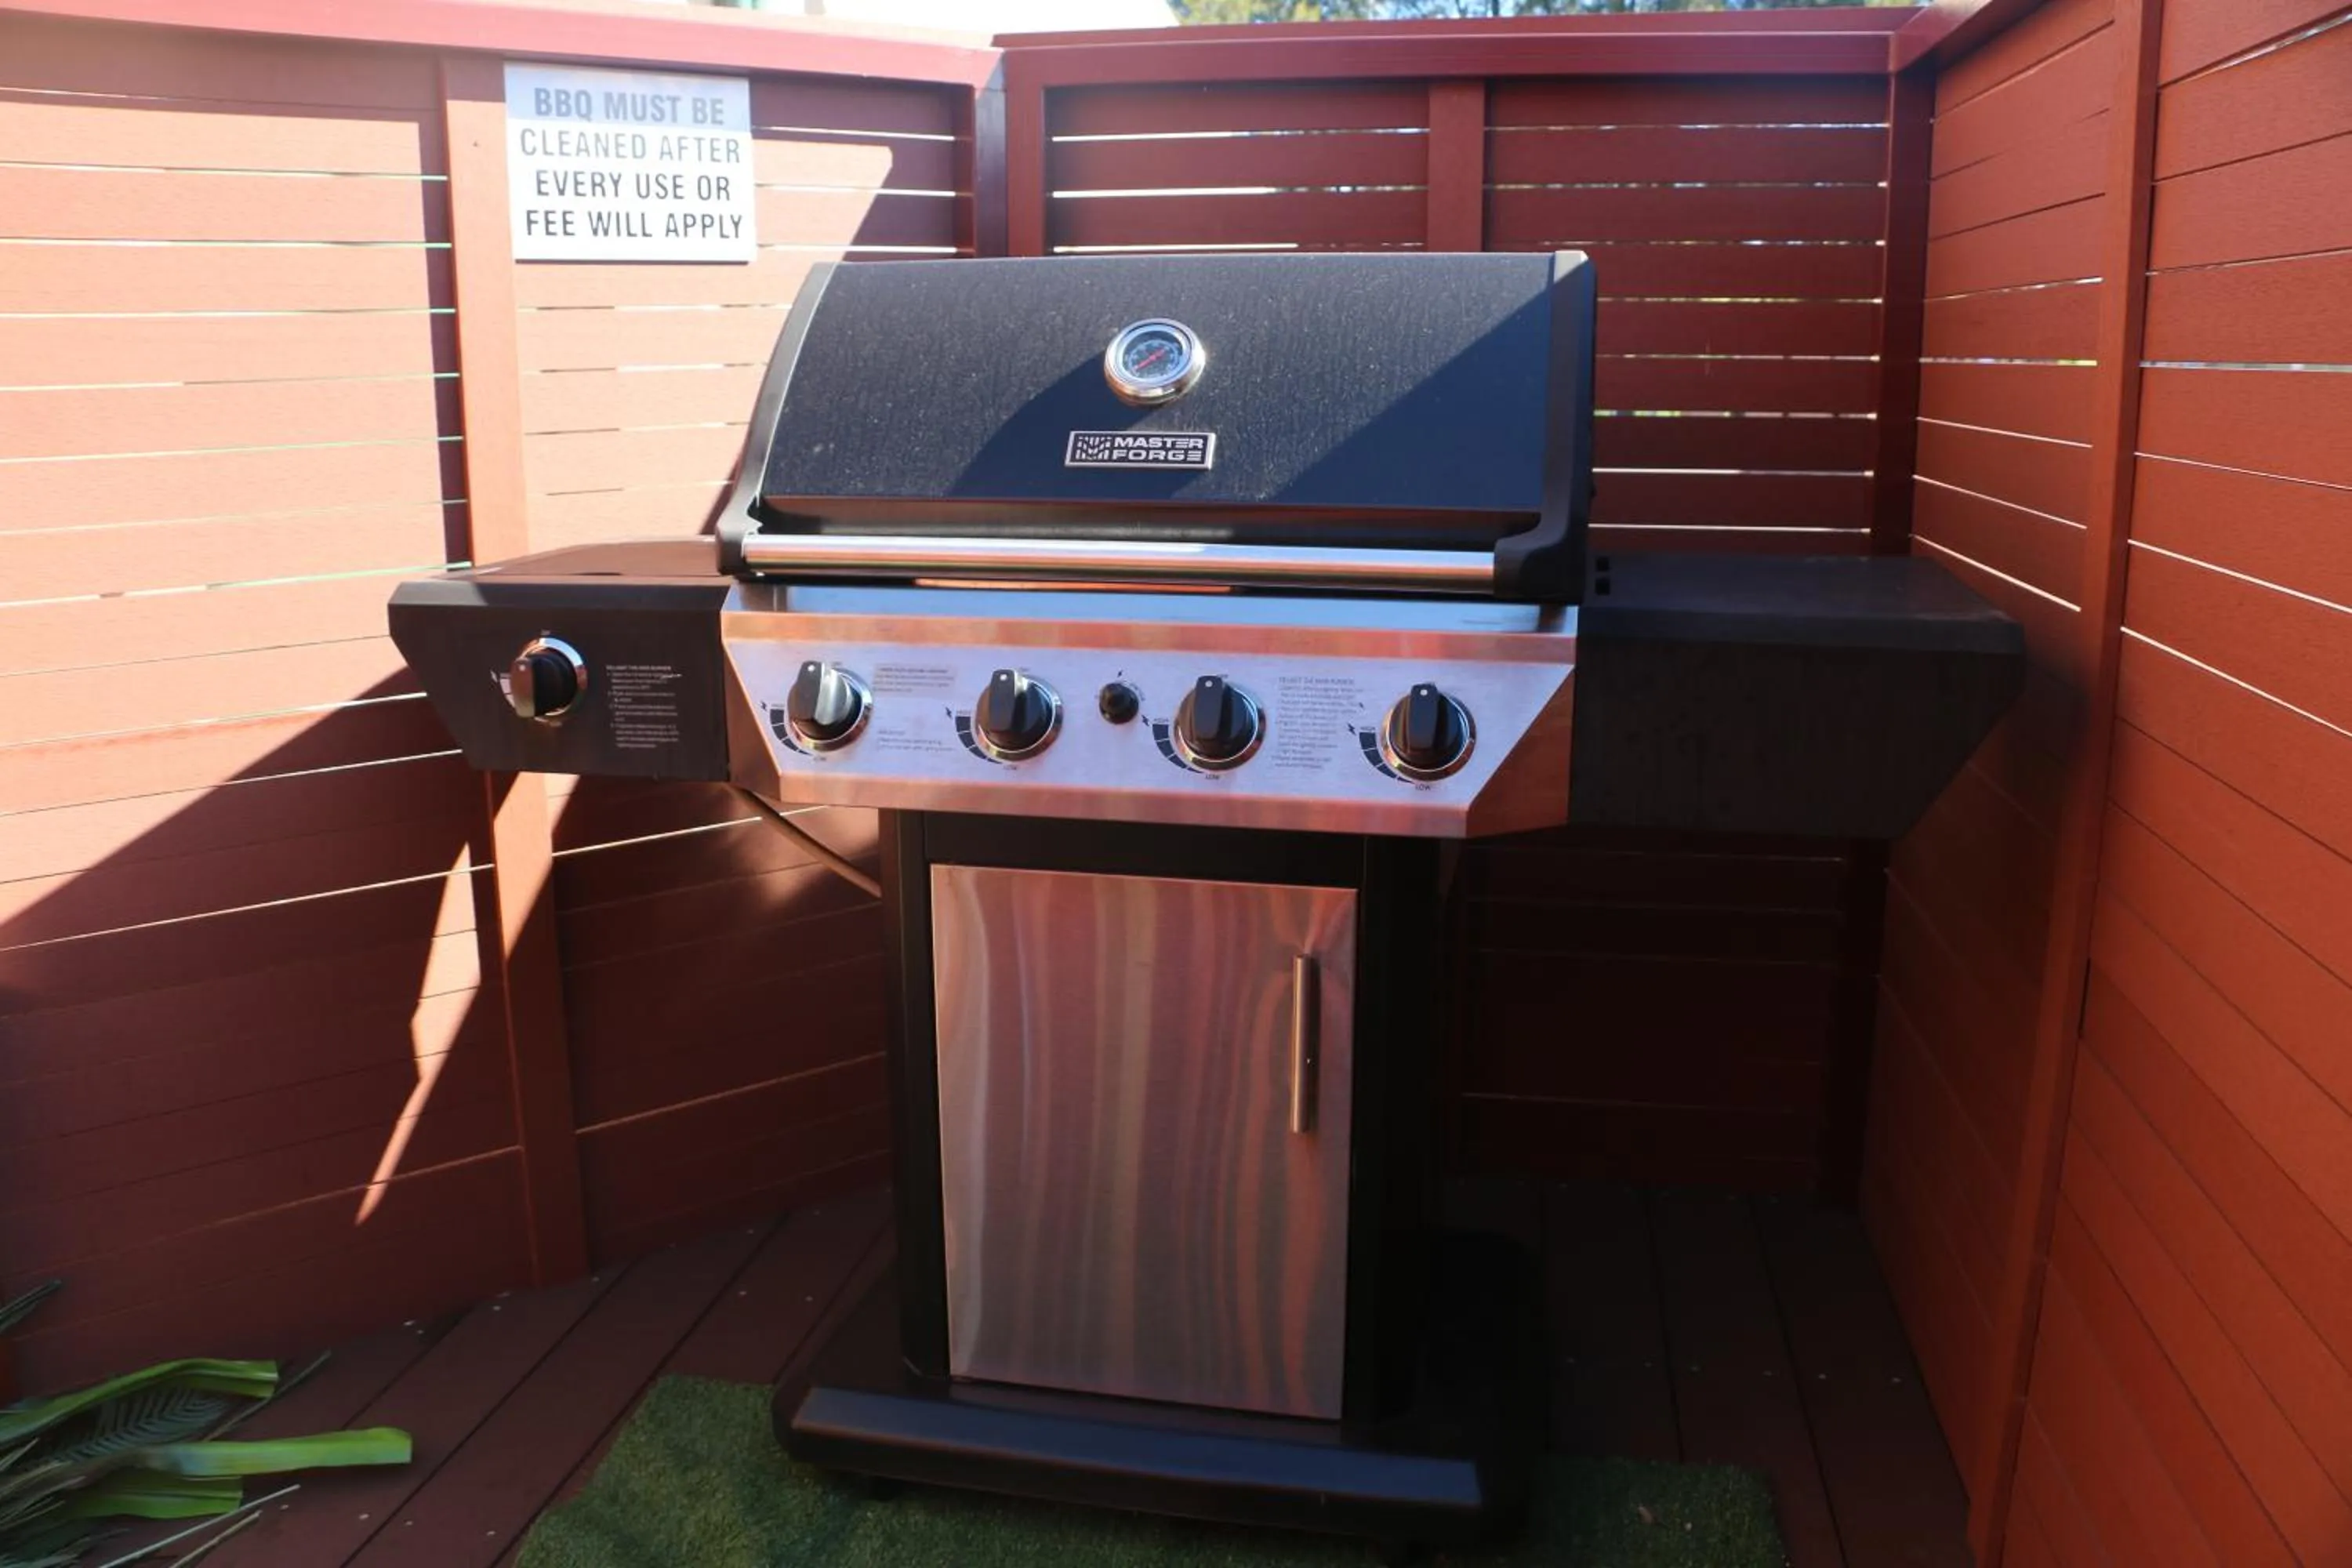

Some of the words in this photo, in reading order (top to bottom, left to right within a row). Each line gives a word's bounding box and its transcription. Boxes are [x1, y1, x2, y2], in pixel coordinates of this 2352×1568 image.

[534, 87, 593, 122] BBQ
[604, 92, 681, 123] MUST
[692, 98, 724, 125] BE
[520, 128, 647, 159] CLEANED
[659, 136, 740, 163] AFTER
[535, 169, 622, 198] EVERY
[635, 172, 684, 200] USE
[697, 175, 731, 201] OR
[526, 209, 575, 236] FEE
[588, 211, 652, 238] WILL
[665, 212, 742, 239] APPLY
[1112, 449, 1202, 461] FORGE
[1114, 437, 1204, 448] MASTER
